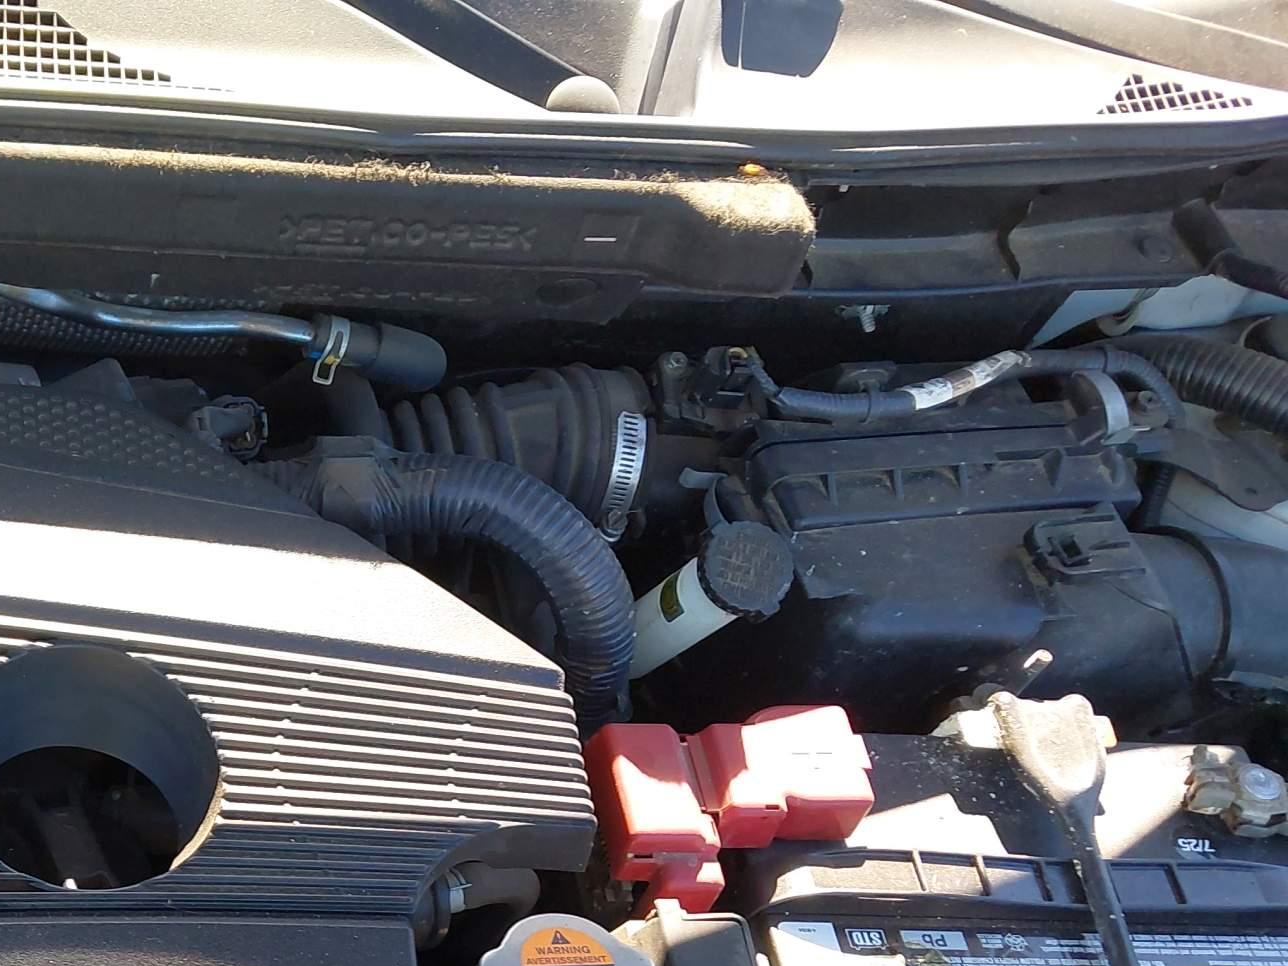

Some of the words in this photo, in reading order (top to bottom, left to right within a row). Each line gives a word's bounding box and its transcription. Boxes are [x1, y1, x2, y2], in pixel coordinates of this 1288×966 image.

[1177, 838, 1217, 853] 7/25
[851, 931, 882, 946] STD
[921, 933, 948, 948] Pb
[535, 945, 592, 955] WARNING
[526, 955, 608, 965] AVERTISSEMENT
